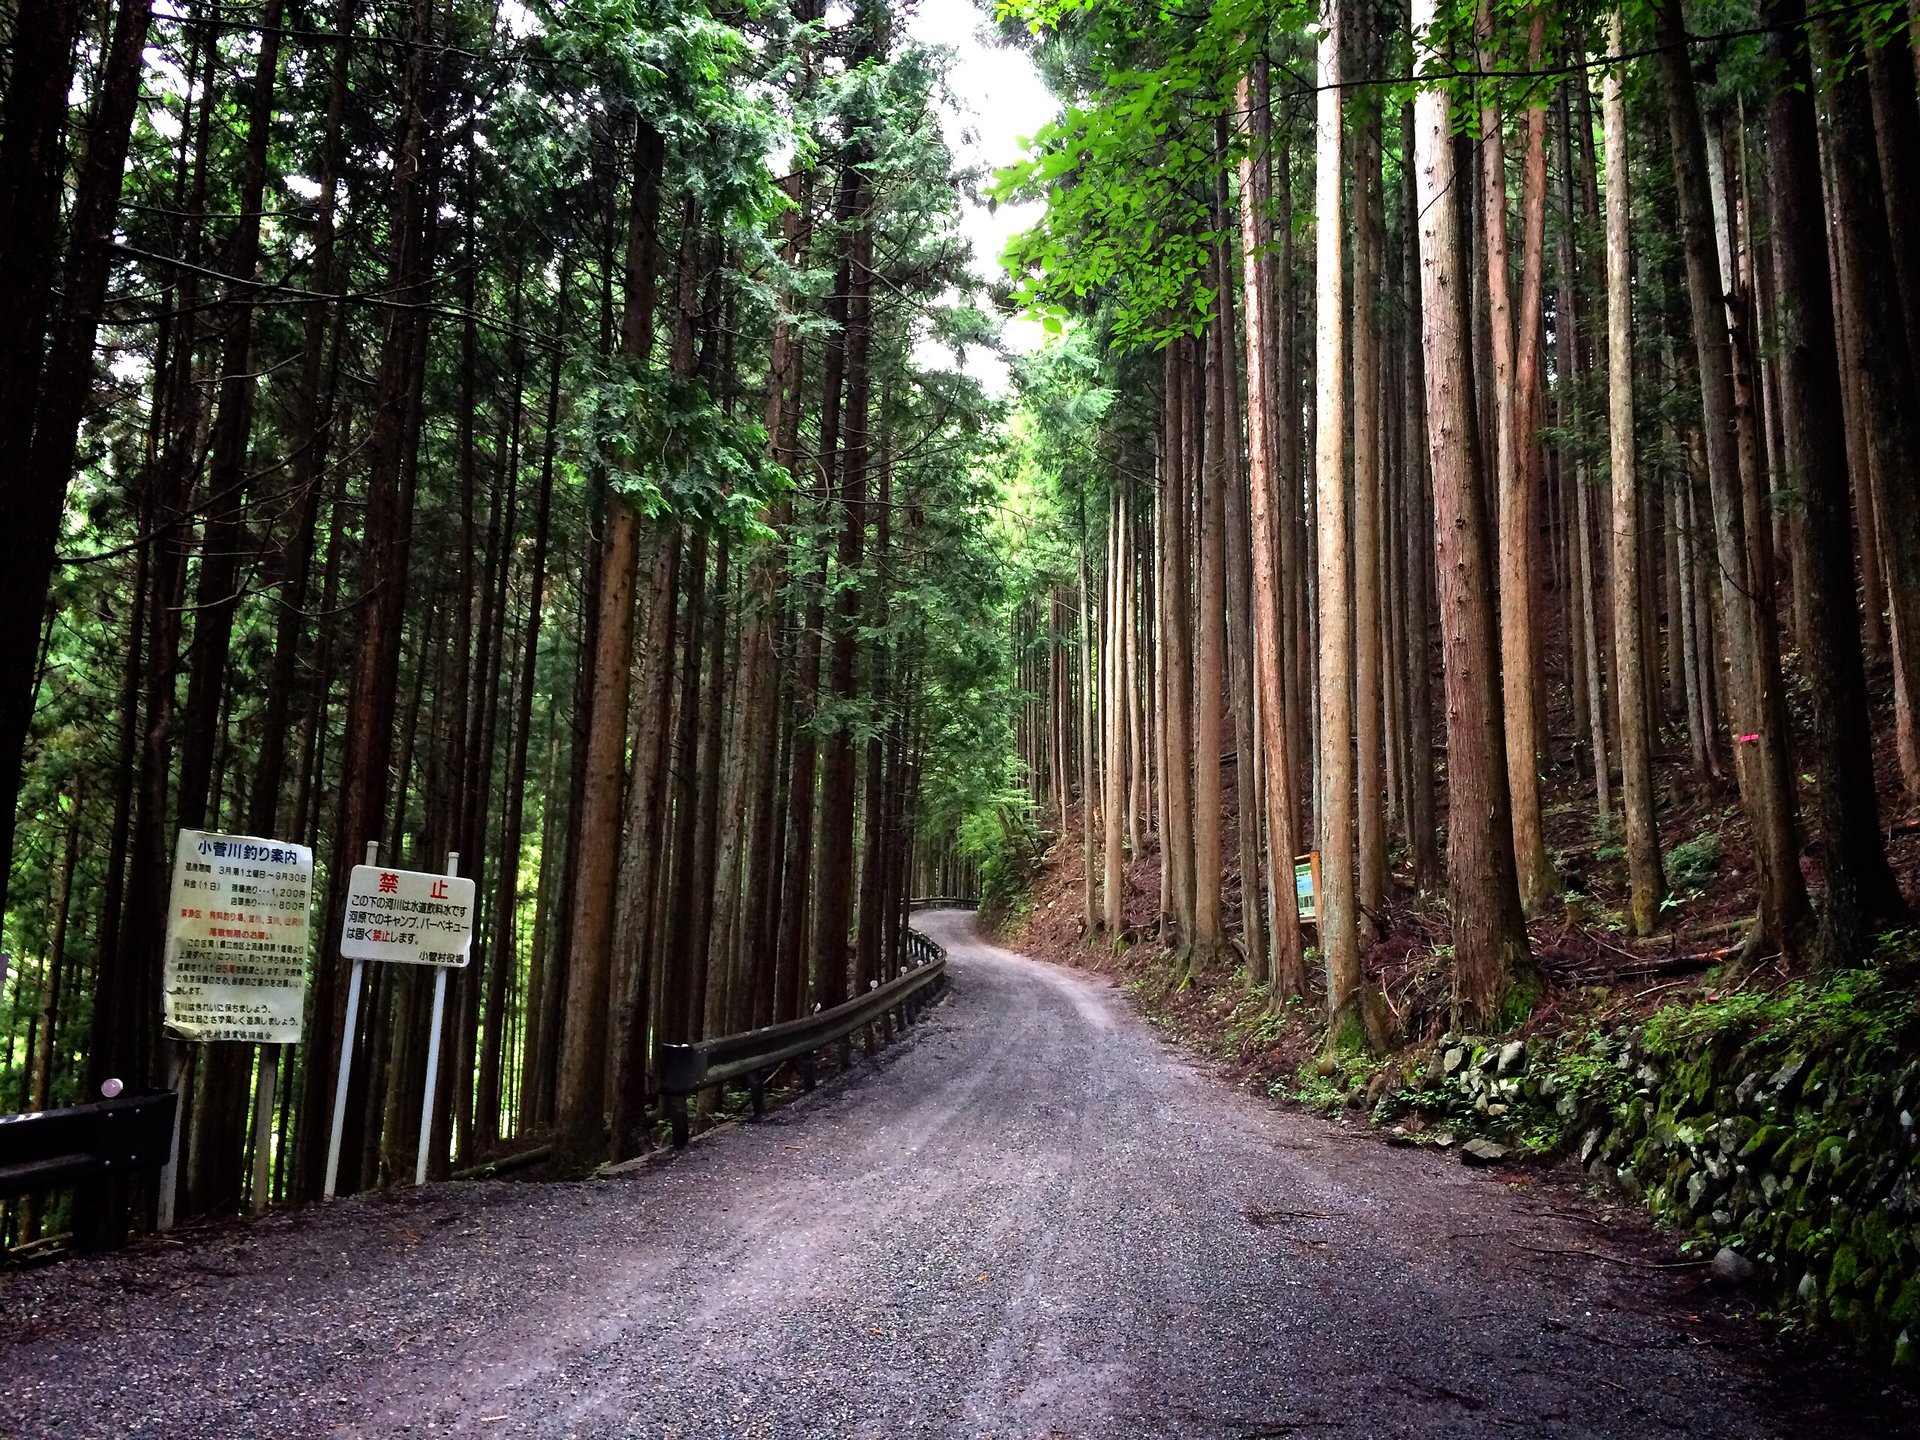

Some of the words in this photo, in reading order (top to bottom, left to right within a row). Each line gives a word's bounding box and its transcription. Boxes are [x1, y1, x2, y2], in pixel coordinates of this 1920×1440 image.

[198, 840, 297, 865] 小菅川釣り案内
[351, 894, 468, 917] この下の河川は水道飲料水です
[346, 927, 419, 946] は固く禁止します。
[418, 950, 465, 964] 小菅村役場
